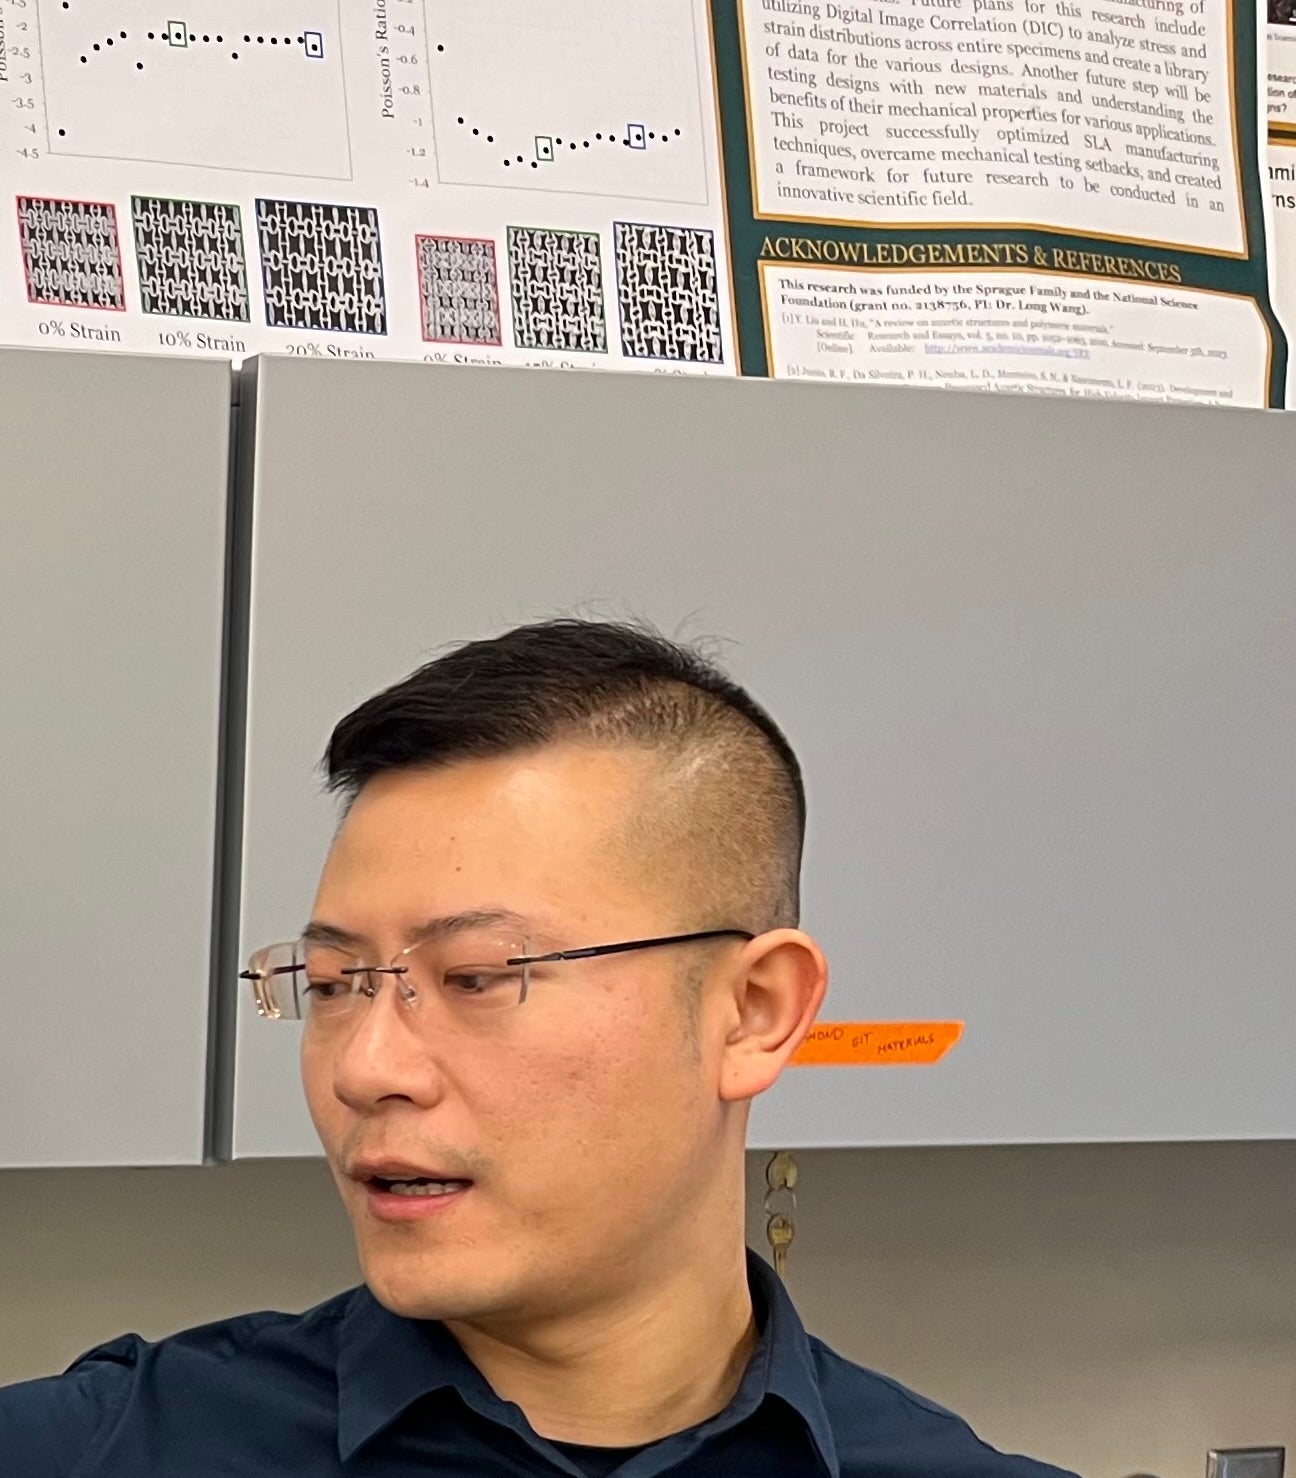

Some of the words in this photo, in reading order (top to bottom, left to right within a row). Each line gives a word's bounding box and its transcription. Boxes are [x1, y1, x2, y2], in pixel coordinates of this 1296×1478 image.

[826, 3, 873, 25] Digital
[879, 11, 924, 32] Image
[930, 15, 1017, 34] Correlation
[1023, 19, 1064, 39] (DIC)
[1069, 26, 1082, 40] to
[1087, 30, 1135, 49] analyze
[1139, 37, 1176, 55] stress
[1181, 44, 1207, 59] and
[1056, 3, 1082, 18] this
[1092, 9, 1146, 29] research
[1155, 18, 1206, 37] include
[764, 20, 805, 38] strain
[809, 26, 901, 49] distributions
[905, 39, 953, 51] across
[957, 41, 1003, 54] entire
[1007, 43, 1082, 61] specimens
[1085, 51, 1109, 65] and
[1112, 55, 1151, 73] create
[1165, 61, 1209, 83] library
[766, 42, 781, 57] of
[788, 44, 819, 63] data
[826, 49, 848, 66] for
[855, 53, 878, 70] the
[886, 58, 942, 73] various
[950, 59, 1014, 79] designs.
[1021, 63, 1078, 83] Another
[1085, 69, 1126, 90] future
[1132, 80, 1159, 98] step
[1165, 85, 1189, 100] will
[1195, 88, 1211, 103] be
[376, 46, 396, 118] Poisson's
[768, 66, 817, 89] testing
[826, 71, 879, 94] designs
[889, 79, 923, 95] with
[935, 84, 966, 96] new
[978, 83, 1048, 100] materials
[1057, 89, 1083, 104] and
[1091, 94, 1185, 123] understanding
[1192, 108, 1214, 125] the
[769, 87, 827, 111] benefits
[831, 97, 845, 112] of
[848, 99, 884, 116] their
[888, 102, 977, 118] mechanical
[982, 106, 1058, 123] properties
[1061, 109, 1081, 125] for
[1085, 115, 1133, 133] various
[1136, 123, 1217, 147] applications.
[771, 111, 804, 129] This
[819, 119, 870, 138] project
[886, 124, 980, 143] successfully
[997, 127, 1070, 146] optimized
[1084, 134, 1112, 152] SLA
[1125, 143, 1221, 172] manufacturing
[774, 136, 857, 160] techniques,
[861, 148, 937, 161] overcame
[941, 146, 1030, 164] mechanical
[1034, 151, 1083, 172] testing
[1085, 159, 1145, 181] setbacks,
[1148, 168, 1172, 184] and
[1175, 174, 1222, 191] created
[796, 160, 876, 182] framework
[887, 168, 910, 183] for
[923, 168, 974, 183] future
[986, 171, 1049, 187] research
[1084, 177, 1100, 193] be
[1110, 183, 1176, 205] conducted
[777, 181, 854, 205] innovative
[858, 191, 928, 206] scientific
[759, 236, 1029, 264] ACKNOWLEDGEMENTS
[1034, 246, 1048, 266] &
[1052, 247, 1183, 284] REFERENCES
[779, 278, 805, 291] This
[807, 281, 857, 295] research
[860, 286, 883, 296] was
[886, 284, 932, 296] funded
[953, 283, 973, 295] the
[976, 283, 1026, 298] Sprague
[1029, 285, 1068, 298] Family
[781, 294, 847, 310] Foundation
[850, 300, 888, 312] (grant
[38, 320, 66, 338] 0%
[70, 322, 121, 343] Strain
[158, 330, 192, 348] 10%
[196, 333, 247, 354] Strain
